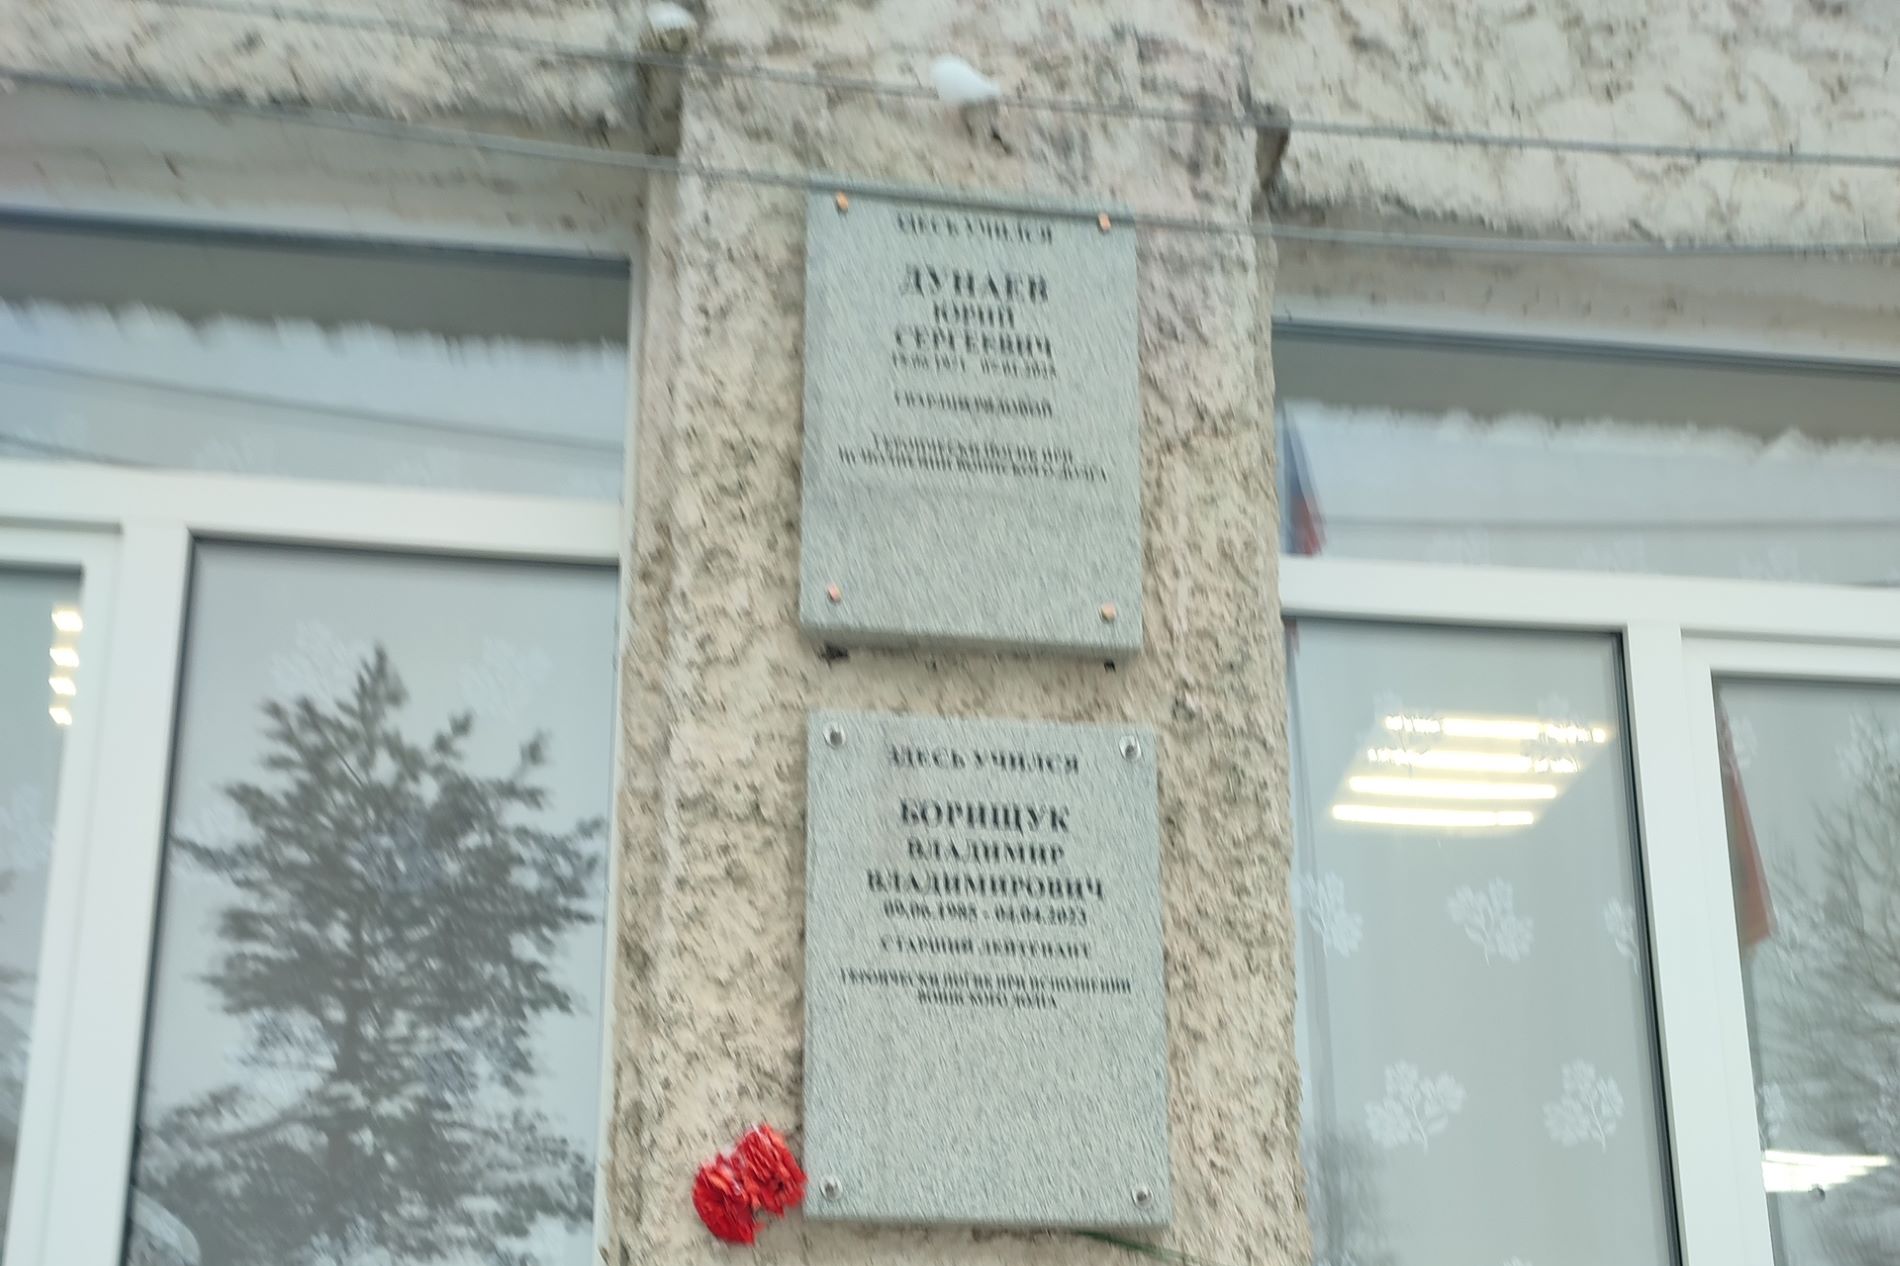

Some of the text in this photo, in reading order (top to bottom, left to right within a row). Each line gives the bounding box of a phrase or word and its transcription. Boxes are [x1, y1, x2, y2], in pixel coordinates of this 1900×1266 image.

[898, 262, 1049, 304] ДУНАЕВ
[932, 301, 1015, 329] ЮРИЙ
[894, 326, 1053, 360] СЕРГЕЕВИЧ
[973, 749, 1080, 775] УЧИЛСЯ
[900, 797, 1071, 836] БОРИЩУК
[906, 836, 1065, 866] ВЛАДИМИР
[866, 868, 1104, 901] ВЛАДИМИРОВИЧ
